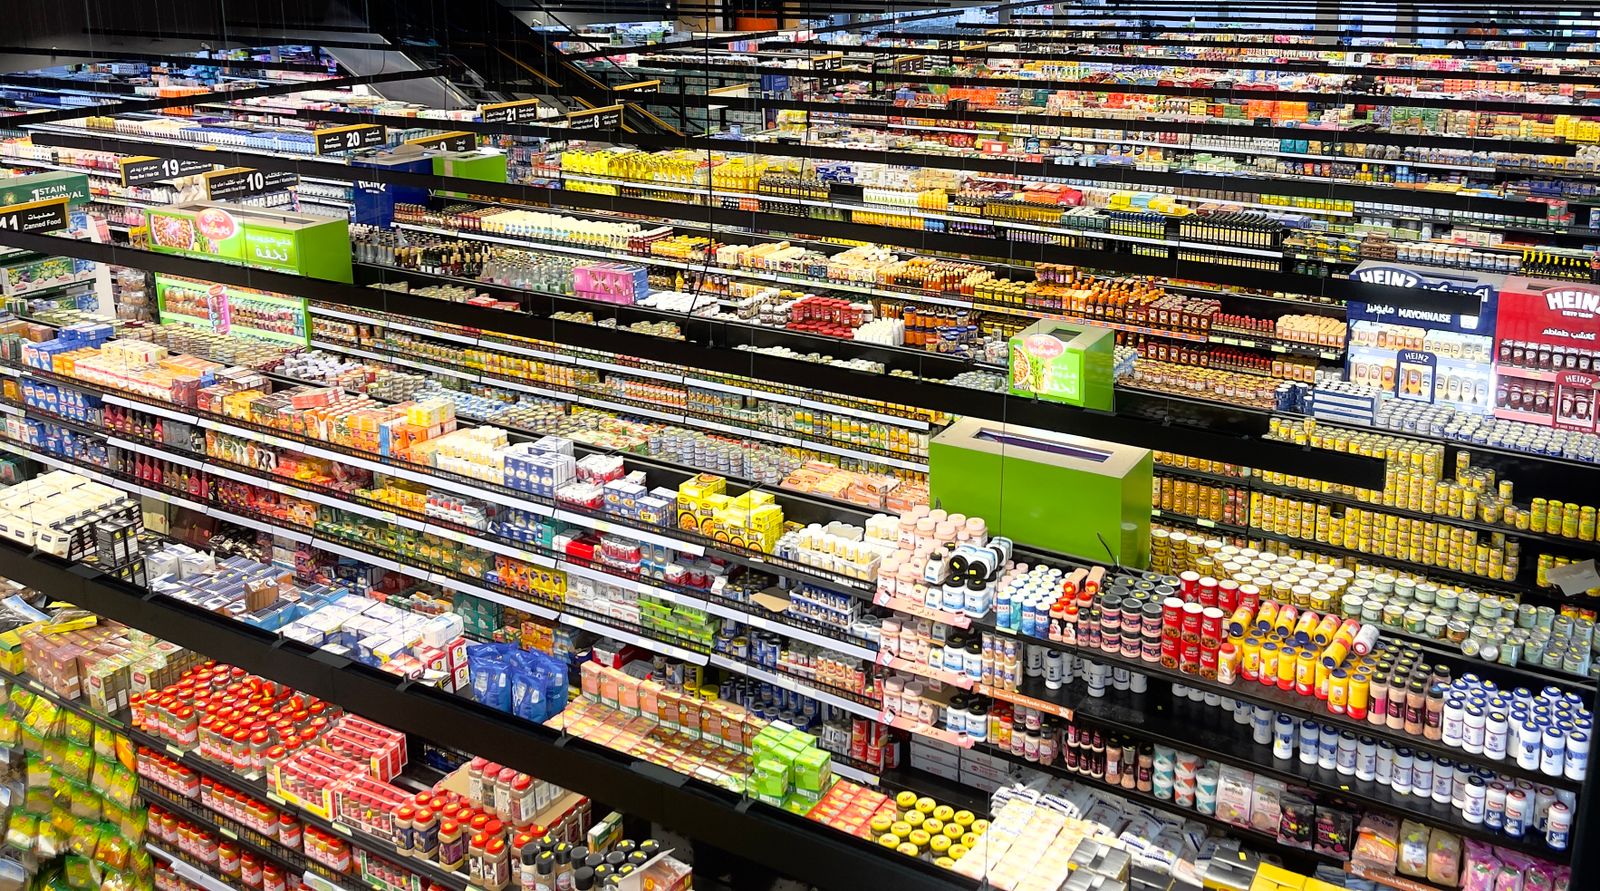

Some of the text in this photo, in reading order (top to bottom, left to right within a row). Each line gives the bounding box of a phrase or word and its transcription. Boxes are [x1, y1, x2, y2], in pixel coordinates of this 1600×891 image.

[506, 108, 516, 121] 21
[593, 115, 600, 128] 8
[346, 131, 360, 148] 20
[162, 159, 179, 176] 19
[247, 172, 264, 191] 10
[40, 185, 66, 195] STAIN
[23, 218, 62, 231] Canned Food
[1365, 303, 1395, 315] مايونيز
[1398, 308, 1452, 324] MAYONNAISE
[1404, 352, 1430, 363] HEINZ
[1565, 374, 1593, 386] HEINZ
